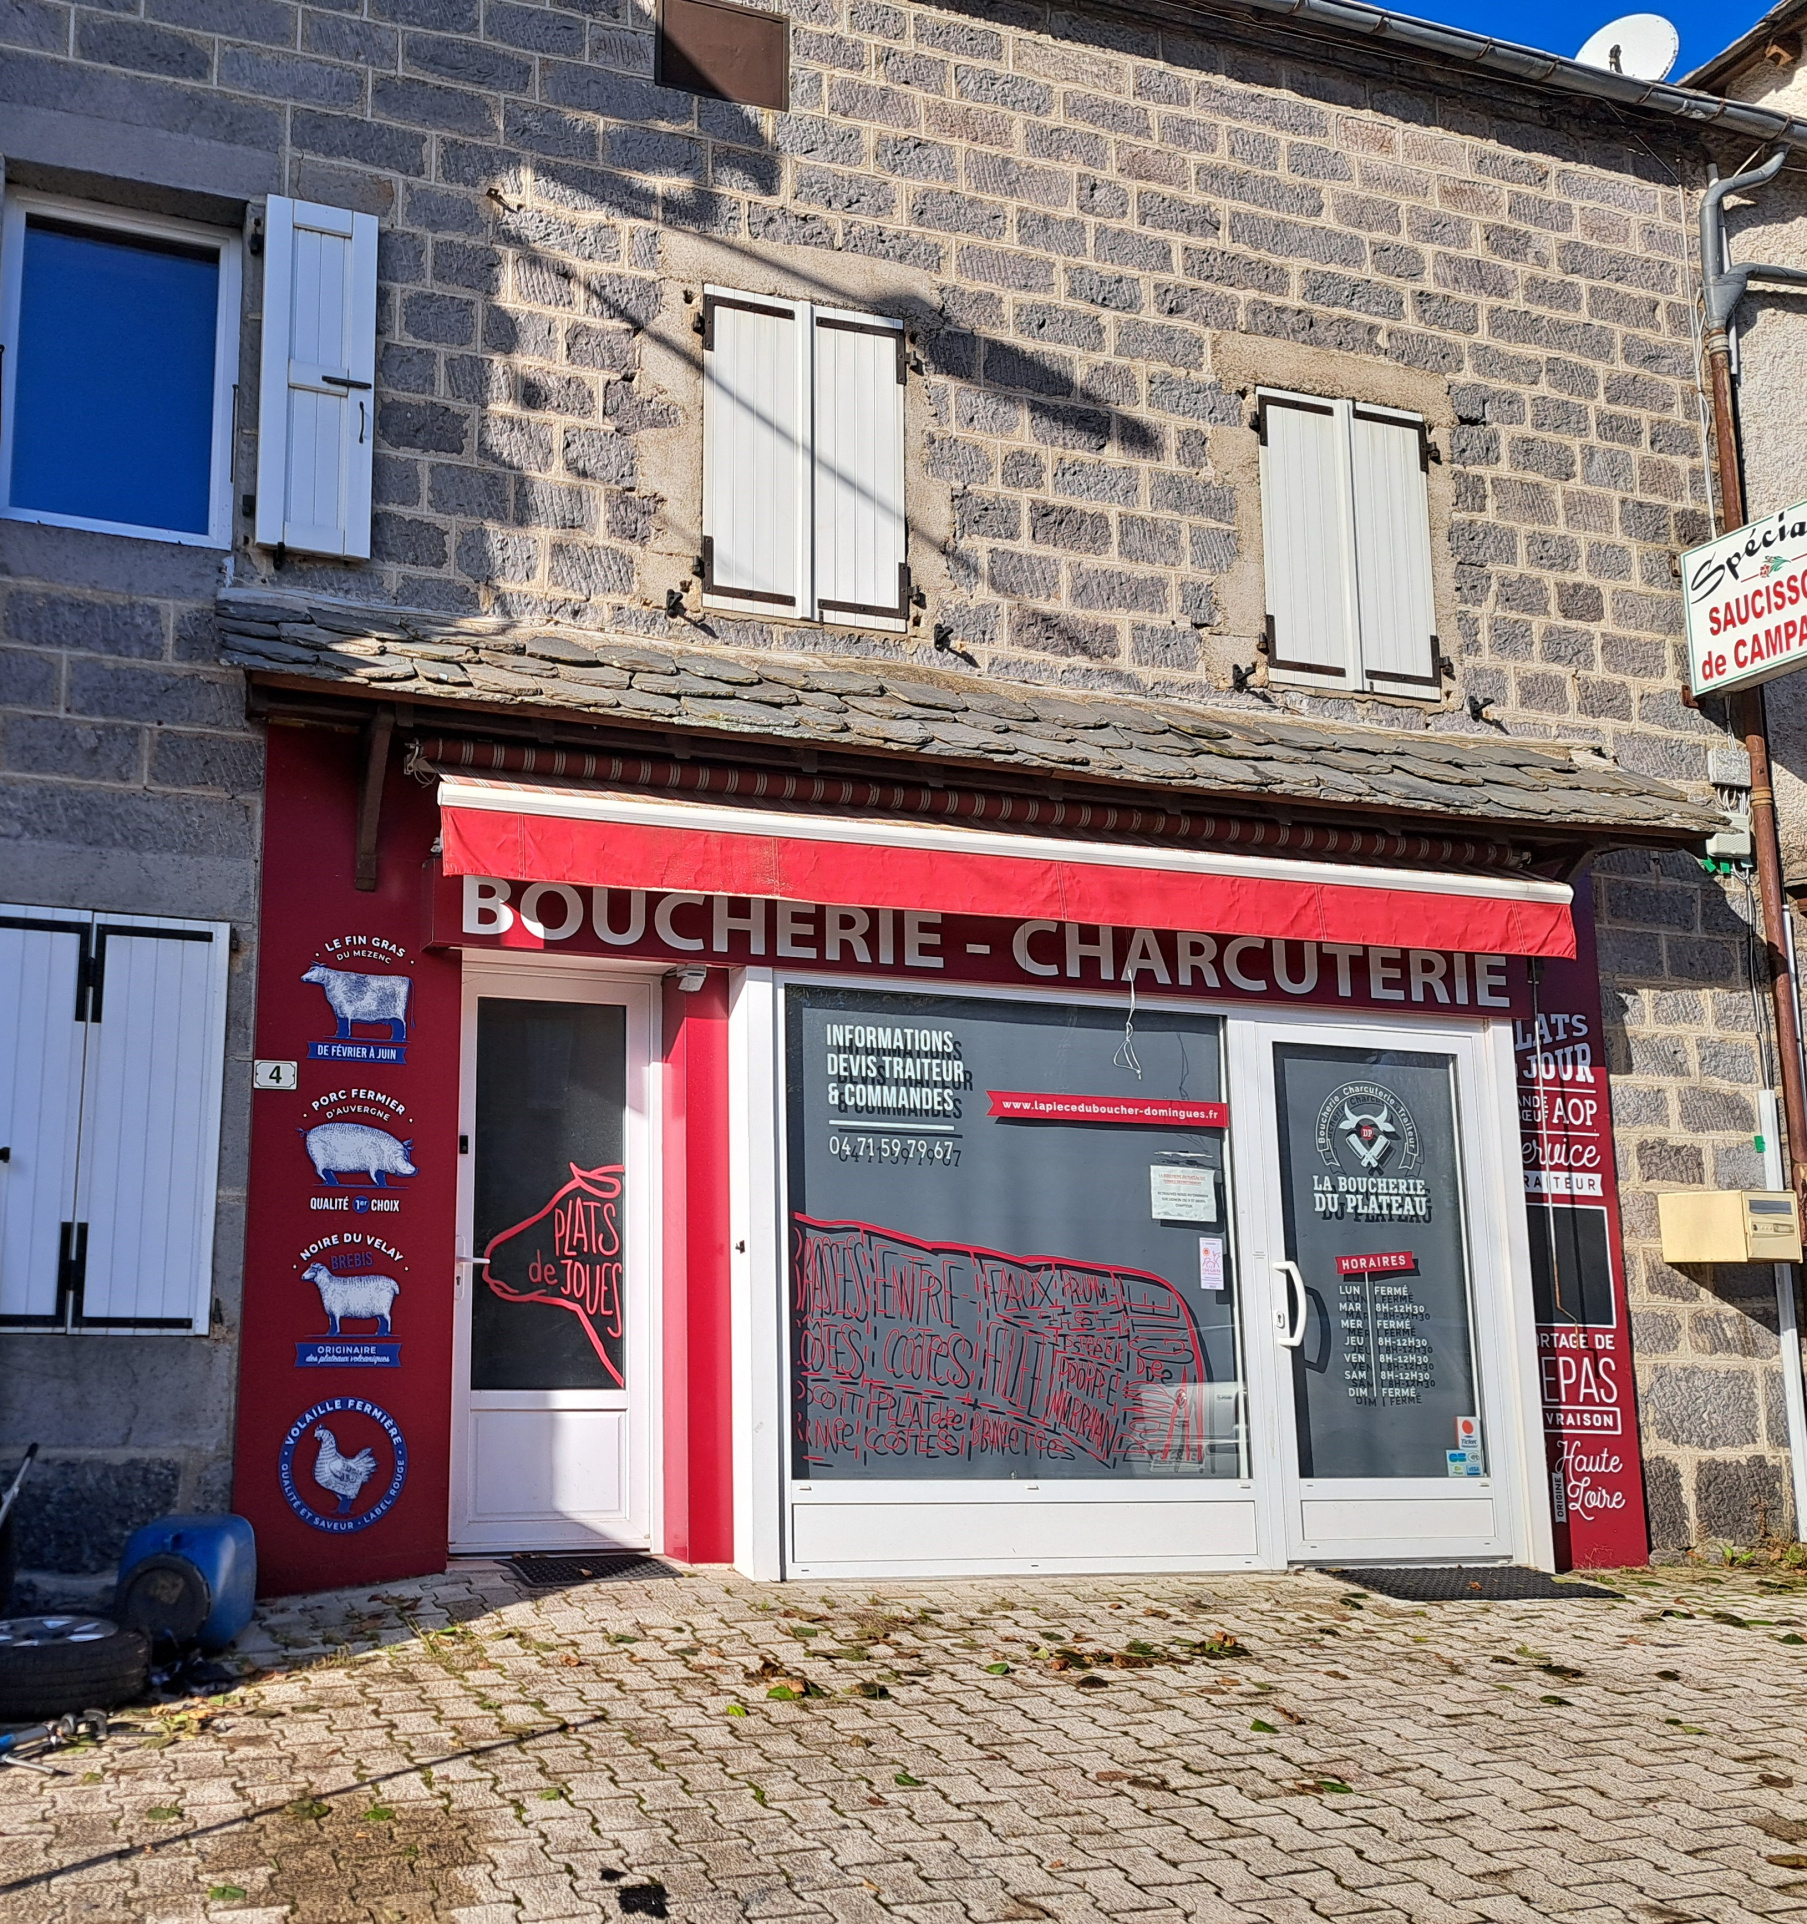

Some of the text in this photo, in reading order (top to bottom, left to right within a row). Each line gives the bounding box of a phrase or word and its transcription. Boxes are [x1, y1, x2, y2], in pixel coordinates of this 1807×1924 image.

[1702, 651, 1727, 680] de
[325, 935, 406, 957] LE FIN GRAS
[462, 875, 945, 968] BOUCHERIE
[1012, 920, 1510, 1008] CHARCUTERIE
[336, 950, 391, 964] DU MEZENC
[826, 1024, 954, 1052] INFORMATIONS
[317, 1044, 396, 1060] DE FÉVRIER À JUIN
[1523, 1042, 1594, 1083] JOUR
[269, 1065, 282, 1084] 4
[826, 1053, 965, 1083] DEVIS TRAITEUR
[311, 1089, 405, 1115] PORC FERMIER
[828, 1083, 954, 1111] & COMMANDES
[326, 1105, 391, 1121] D'AUVERGNE
[1002, 1100, 1219, 1120] www.lapieceduboucher-domingues.fr
[1318, 1086, 1415, 1149] Boucherie Charcuterie Traiteur
[1520, 1109, 1549, 1122] ŒUF
[1552, 1097, 1597, 1126] AOP
[829, 1136, 953, 1159] 04 71 59 79 67
[1313, 1175, 1426, 1194] LA BOUCHERIE
[1524, 1175, 1596, 1190] RATEUR
[310, 1196, 400, 1212] QUALITÉ 1er CHOIX
[1314, 1193, 1427, 1216] DU PLATEAU
[555, 1196, 619, 1256] PLATS
[300, 1233, 404, 1261] NOIRE DU VELAY
[331, 1252, 373, 1270] BREBIS
[1342, 1255, 1406, 1270] HORAIRES
[528, 1250, 622, 1338] de JOUES
[982, 1264, 1046, 1306] FAUX
[1339, 1284, 1408, 1295] LUN FERMÉ
[1339, 1303, 1425, 1313] MAR 8H-12H30
[1341, 1319, 1411, 1329] MER FERMÉ
[317, 1346, 377, 1354] ORIGINAIRE
[795, 1314, 857, 1374] ÔTES
[1344, 1337, 1427, 1347] JEU 8H-12H30
[1536, 1333, 1616, 1350] RTAGE DE
[1344, 1354, 1429, 1363] VEN 8H-12H30
[1344, 1371, 1430, 1381] SAM 8H-12H30
[1541, 1356, 1618, 1403] EPAS
[1348, 1387, 1416, 1398] DIM FERMÉ
[285, 1399, 402, 1445] VOLAILLE FERMIÈRE
[1545, 1413, 1614, 1427] VRAISON
[1555, 1440, 1623, 1484] Haute
[281, 1463, 354, 1530] QUALITÉ ET SAVEUR
[363, 1460, 405, 1523] LABEL ROUGE
[1556, 1476, 1625, 1521] ORIGINE Loire
